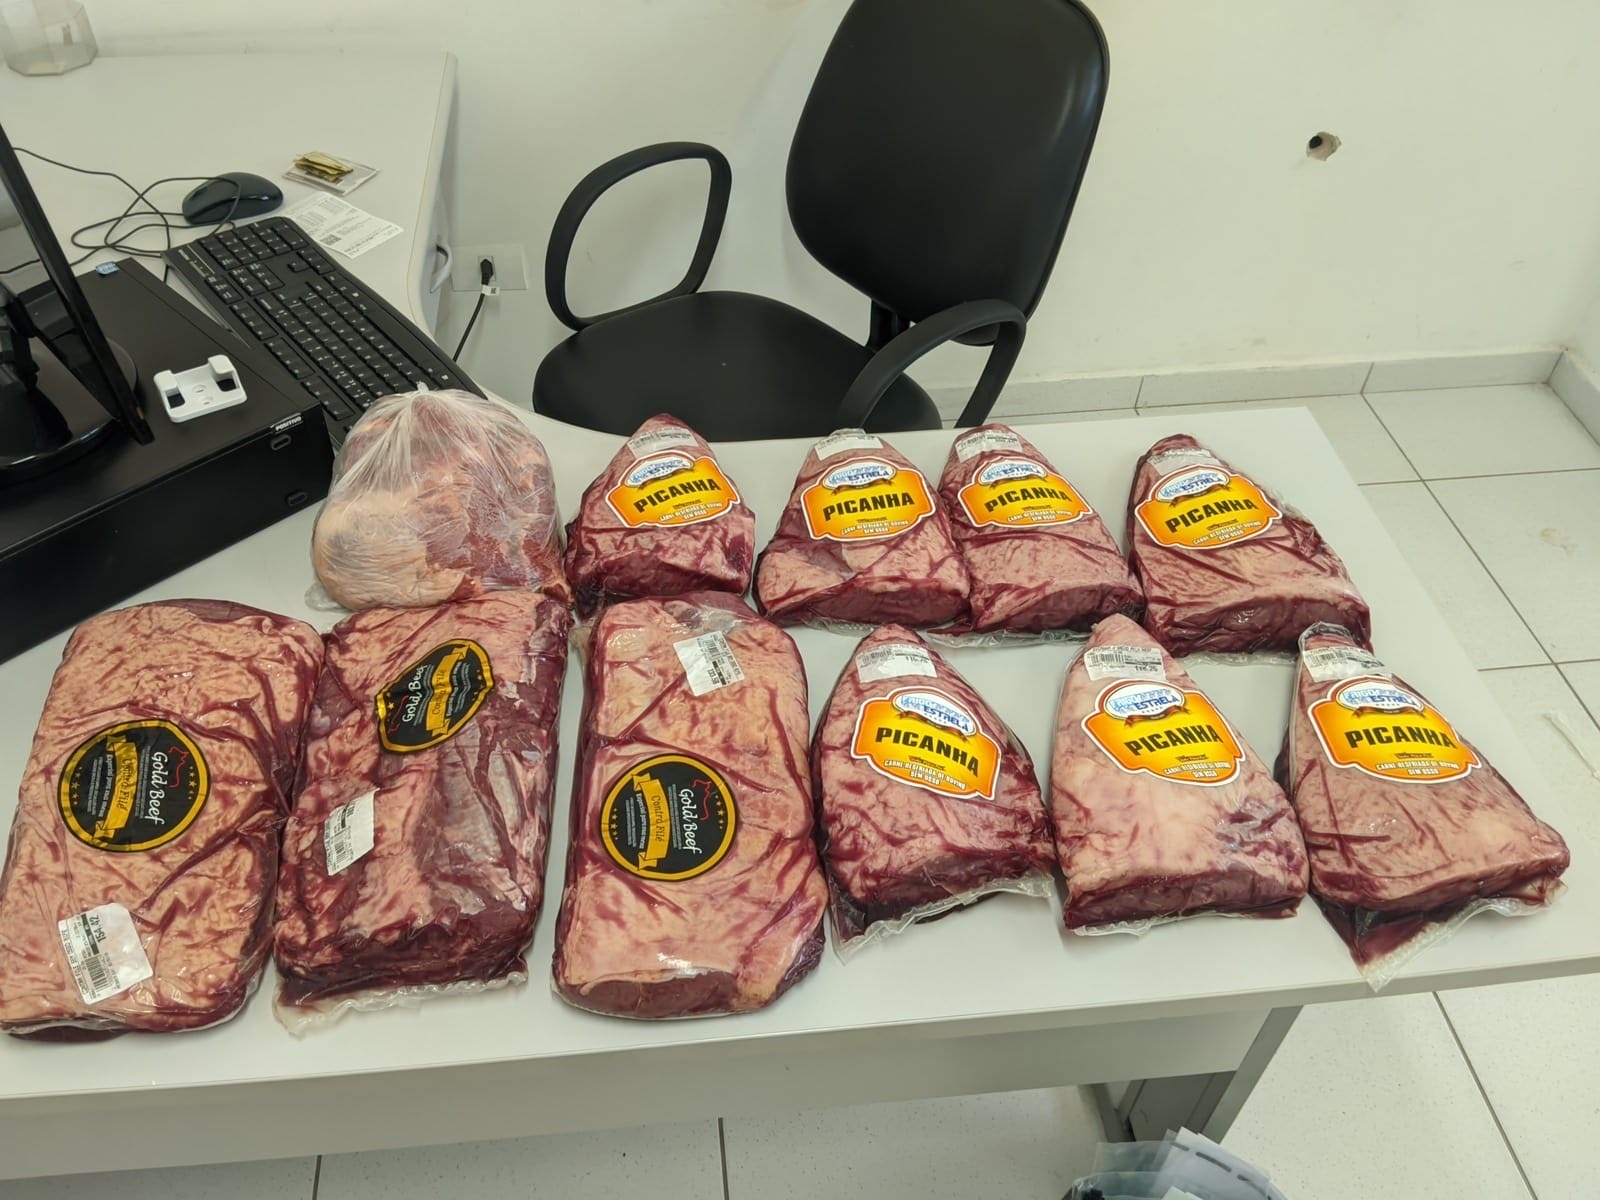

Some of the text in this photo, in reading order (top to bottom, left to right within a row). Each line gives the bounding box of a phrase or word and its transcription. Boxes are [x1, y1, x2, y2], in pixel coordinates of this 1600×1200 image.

[275, 416, 302, 431] POSITIVO
[633, 478, 721, 514] PICANHA
[822, 492, 915, 522] PICANHA
[983, 487, 1073, 513] PICANHA
[1165, 498, 1259, 534] PICANHA
[402, 692, 423, 722] Gold
[1136, 695, 1180, 711] ESTRELA
[923, 705, 970, 732] ESTRELA
[1124, 724, 1224, 756] PICANHA
[1344, 725, 1458, 749] PICANHA
[875, 727, 980, 778] PICANHA
[144, 751, 169, 825] Gold Beef
[651, 795, 666, 843] Contra Filé
[678, 788, 703, 854] Gold Beef
[89, 914, 107, 943] 154.42
